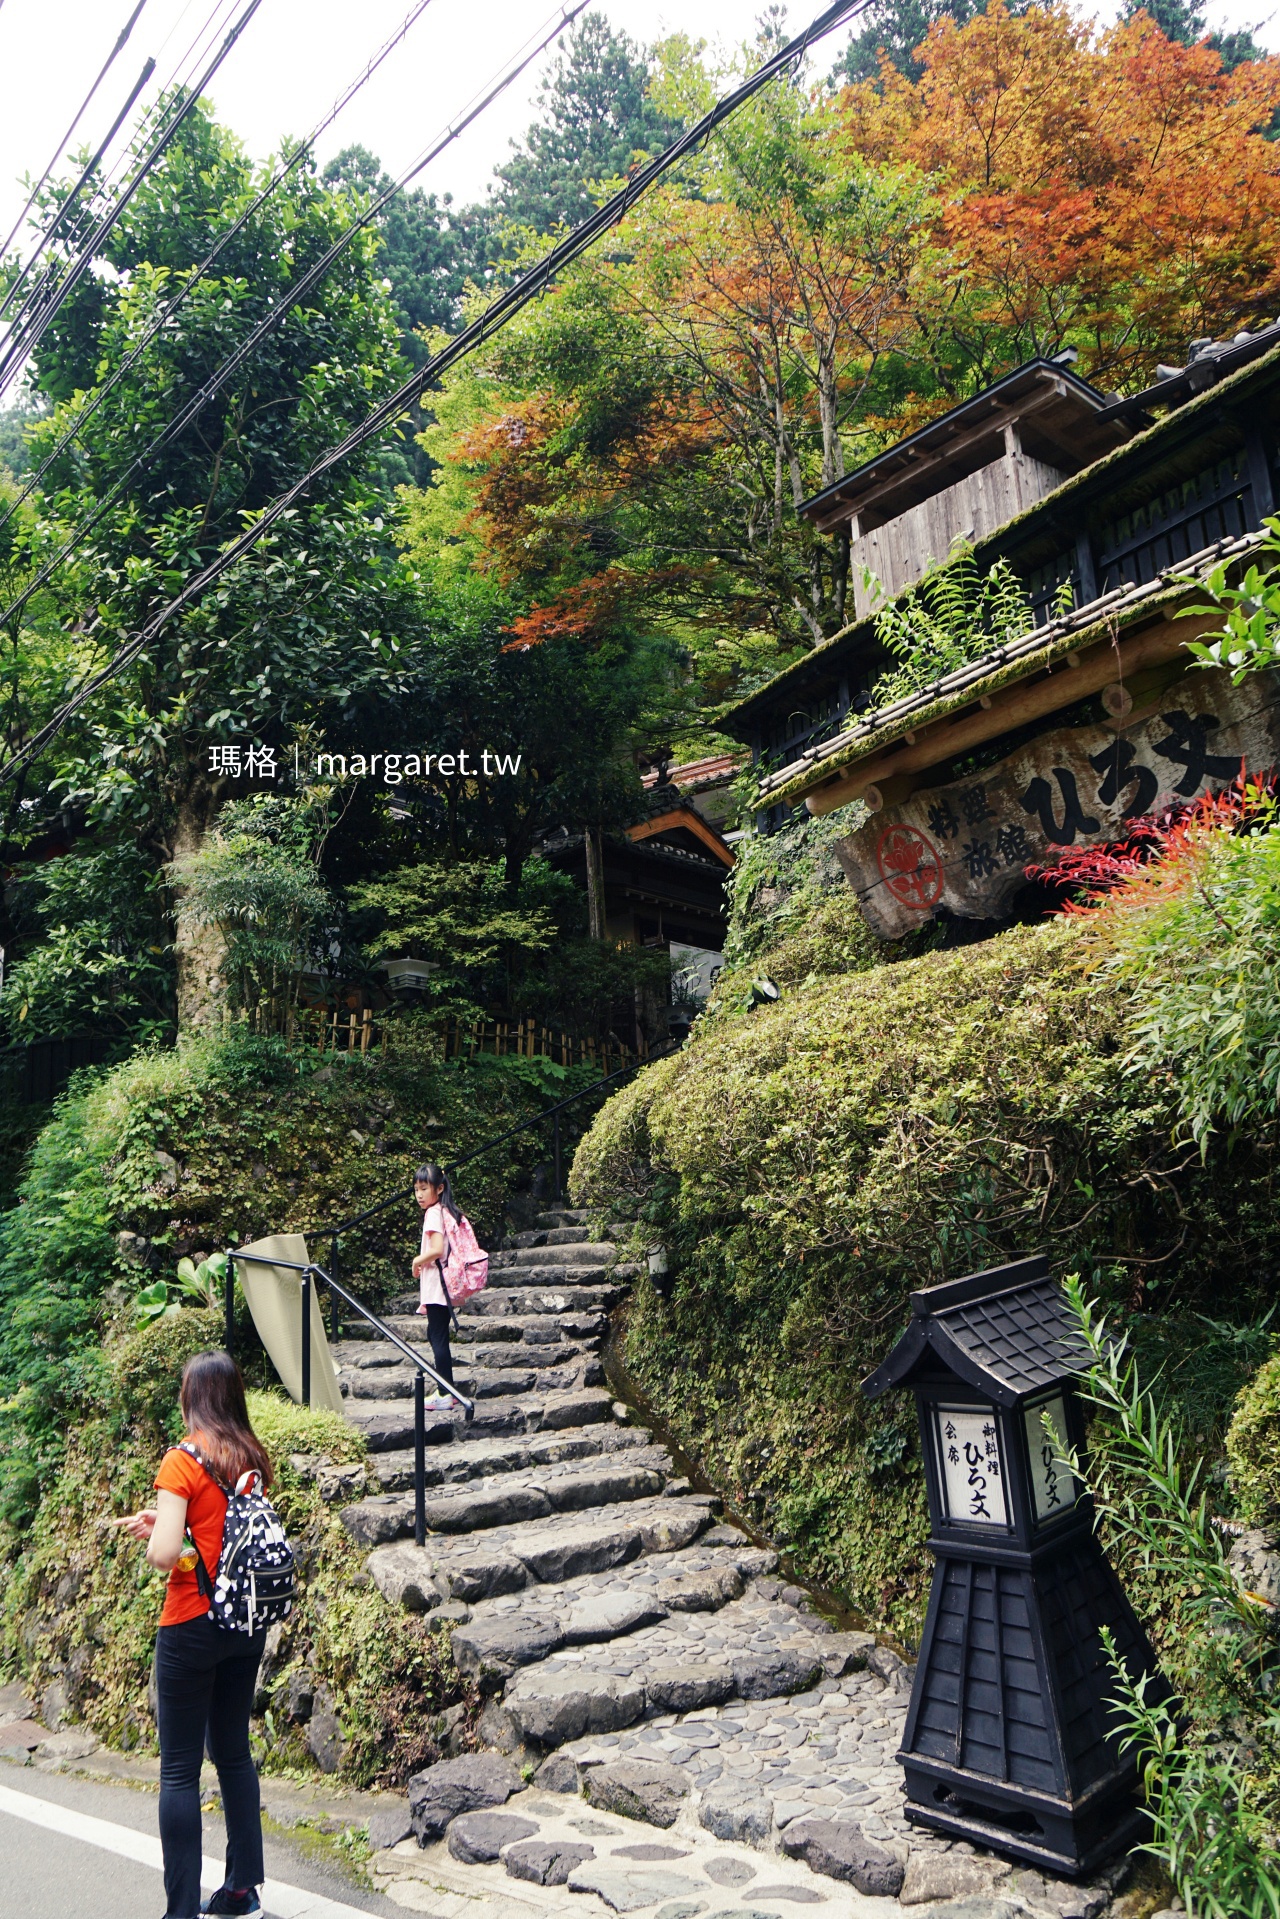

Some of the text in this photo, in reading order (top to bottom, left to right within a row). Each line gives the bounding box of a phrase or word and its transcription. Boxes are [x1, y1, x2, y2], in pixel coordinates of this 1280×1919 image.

[1018, 708, 1246, 846] ひろ文
[927, 784, 998, 840] 料理
[961, 823, 1034, 879] 旅館
[962, 1441, 991, 1519] ひろ文
